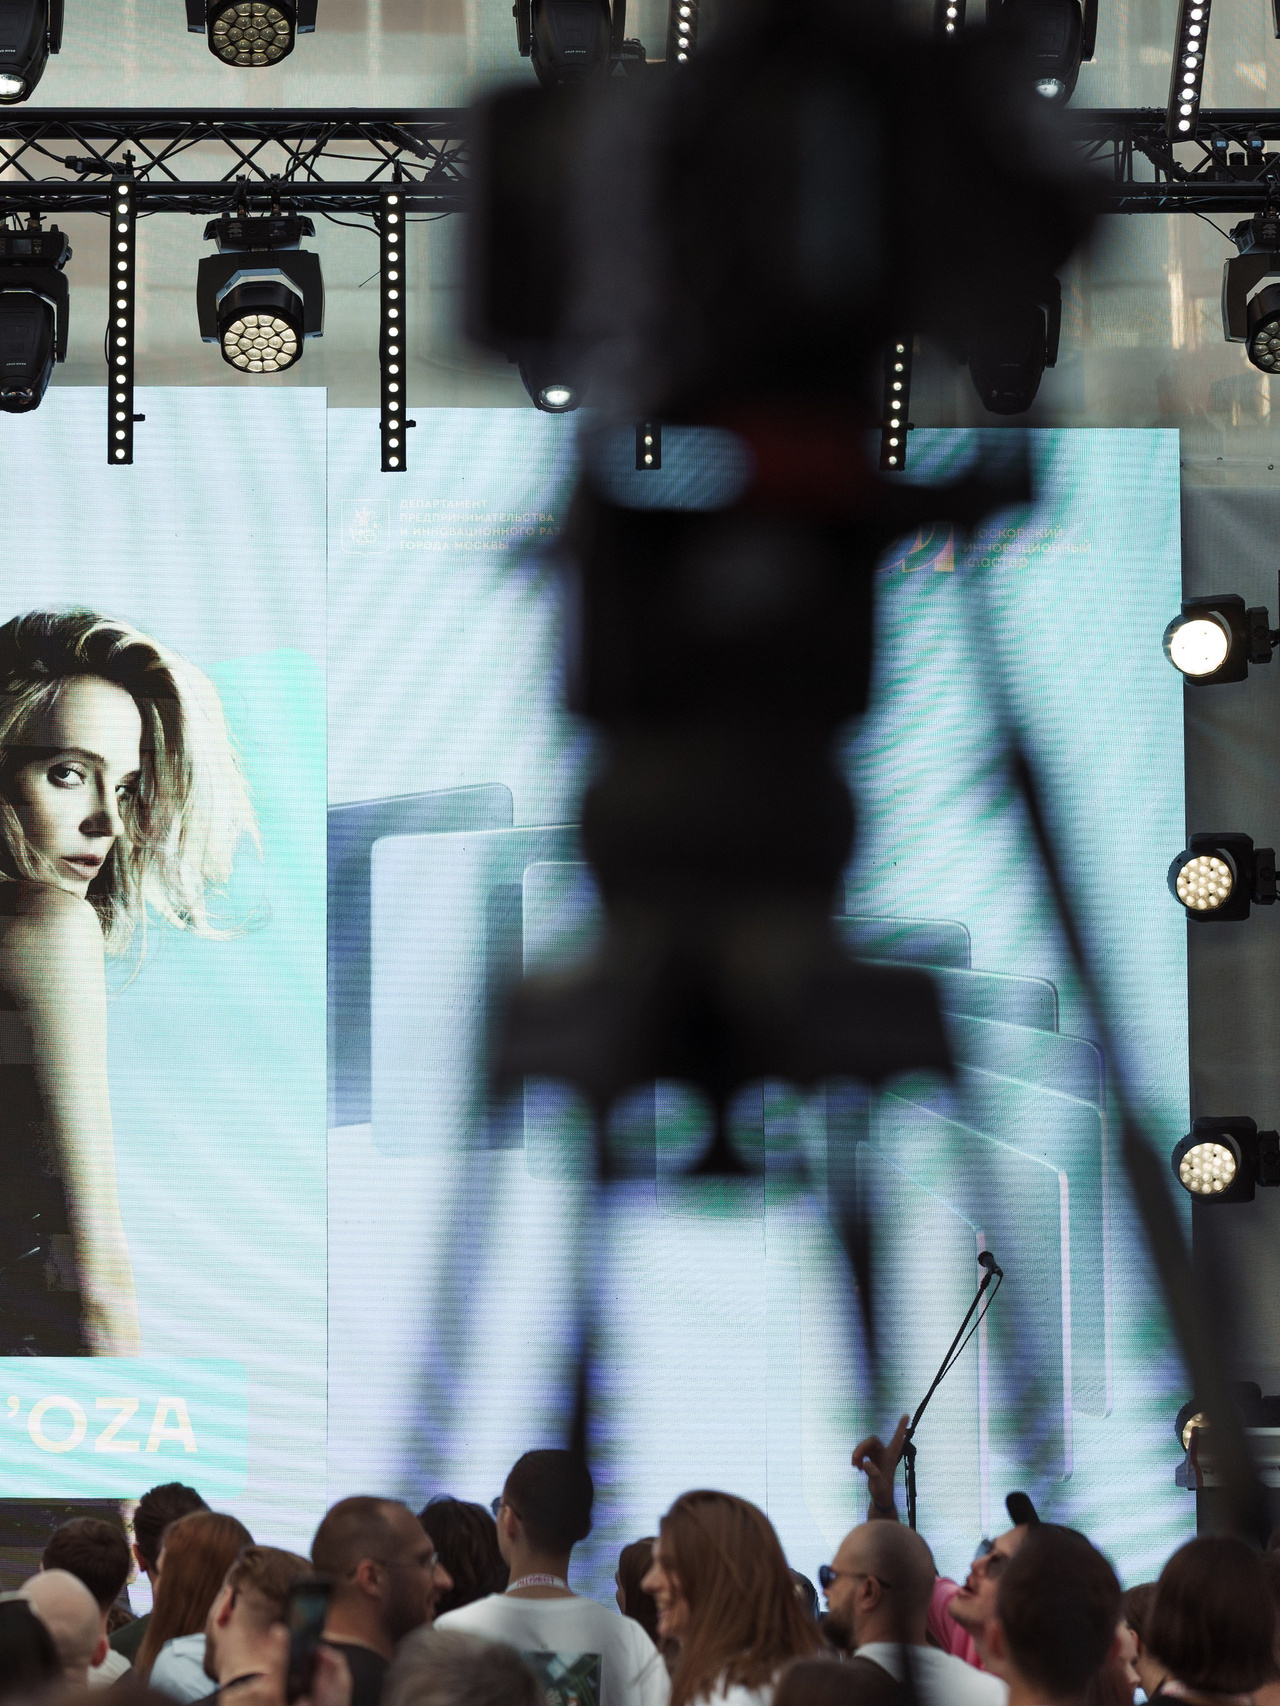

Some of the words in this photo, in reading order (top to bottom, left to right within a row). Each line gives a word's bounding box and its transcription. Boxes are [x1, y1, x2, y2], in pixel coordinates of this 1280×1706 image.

[400, 499, 488, 509] ДЕПАРТАМЕНТ
[400, 512, 555, 524] ПРЕДПРИНИМАТЕЛЬСТВА
[412, 527, 536, 537] ИННОВАЦИОННОГО
[539, 527, 562, 536] РАЗ
[400, 541, 449, 550] ГОРОДА
[454, 541, 510, 550] МОСКВЫ
[963, 540, 1092, 556] инновационный
[964, 557, 1029, 571] кластер
